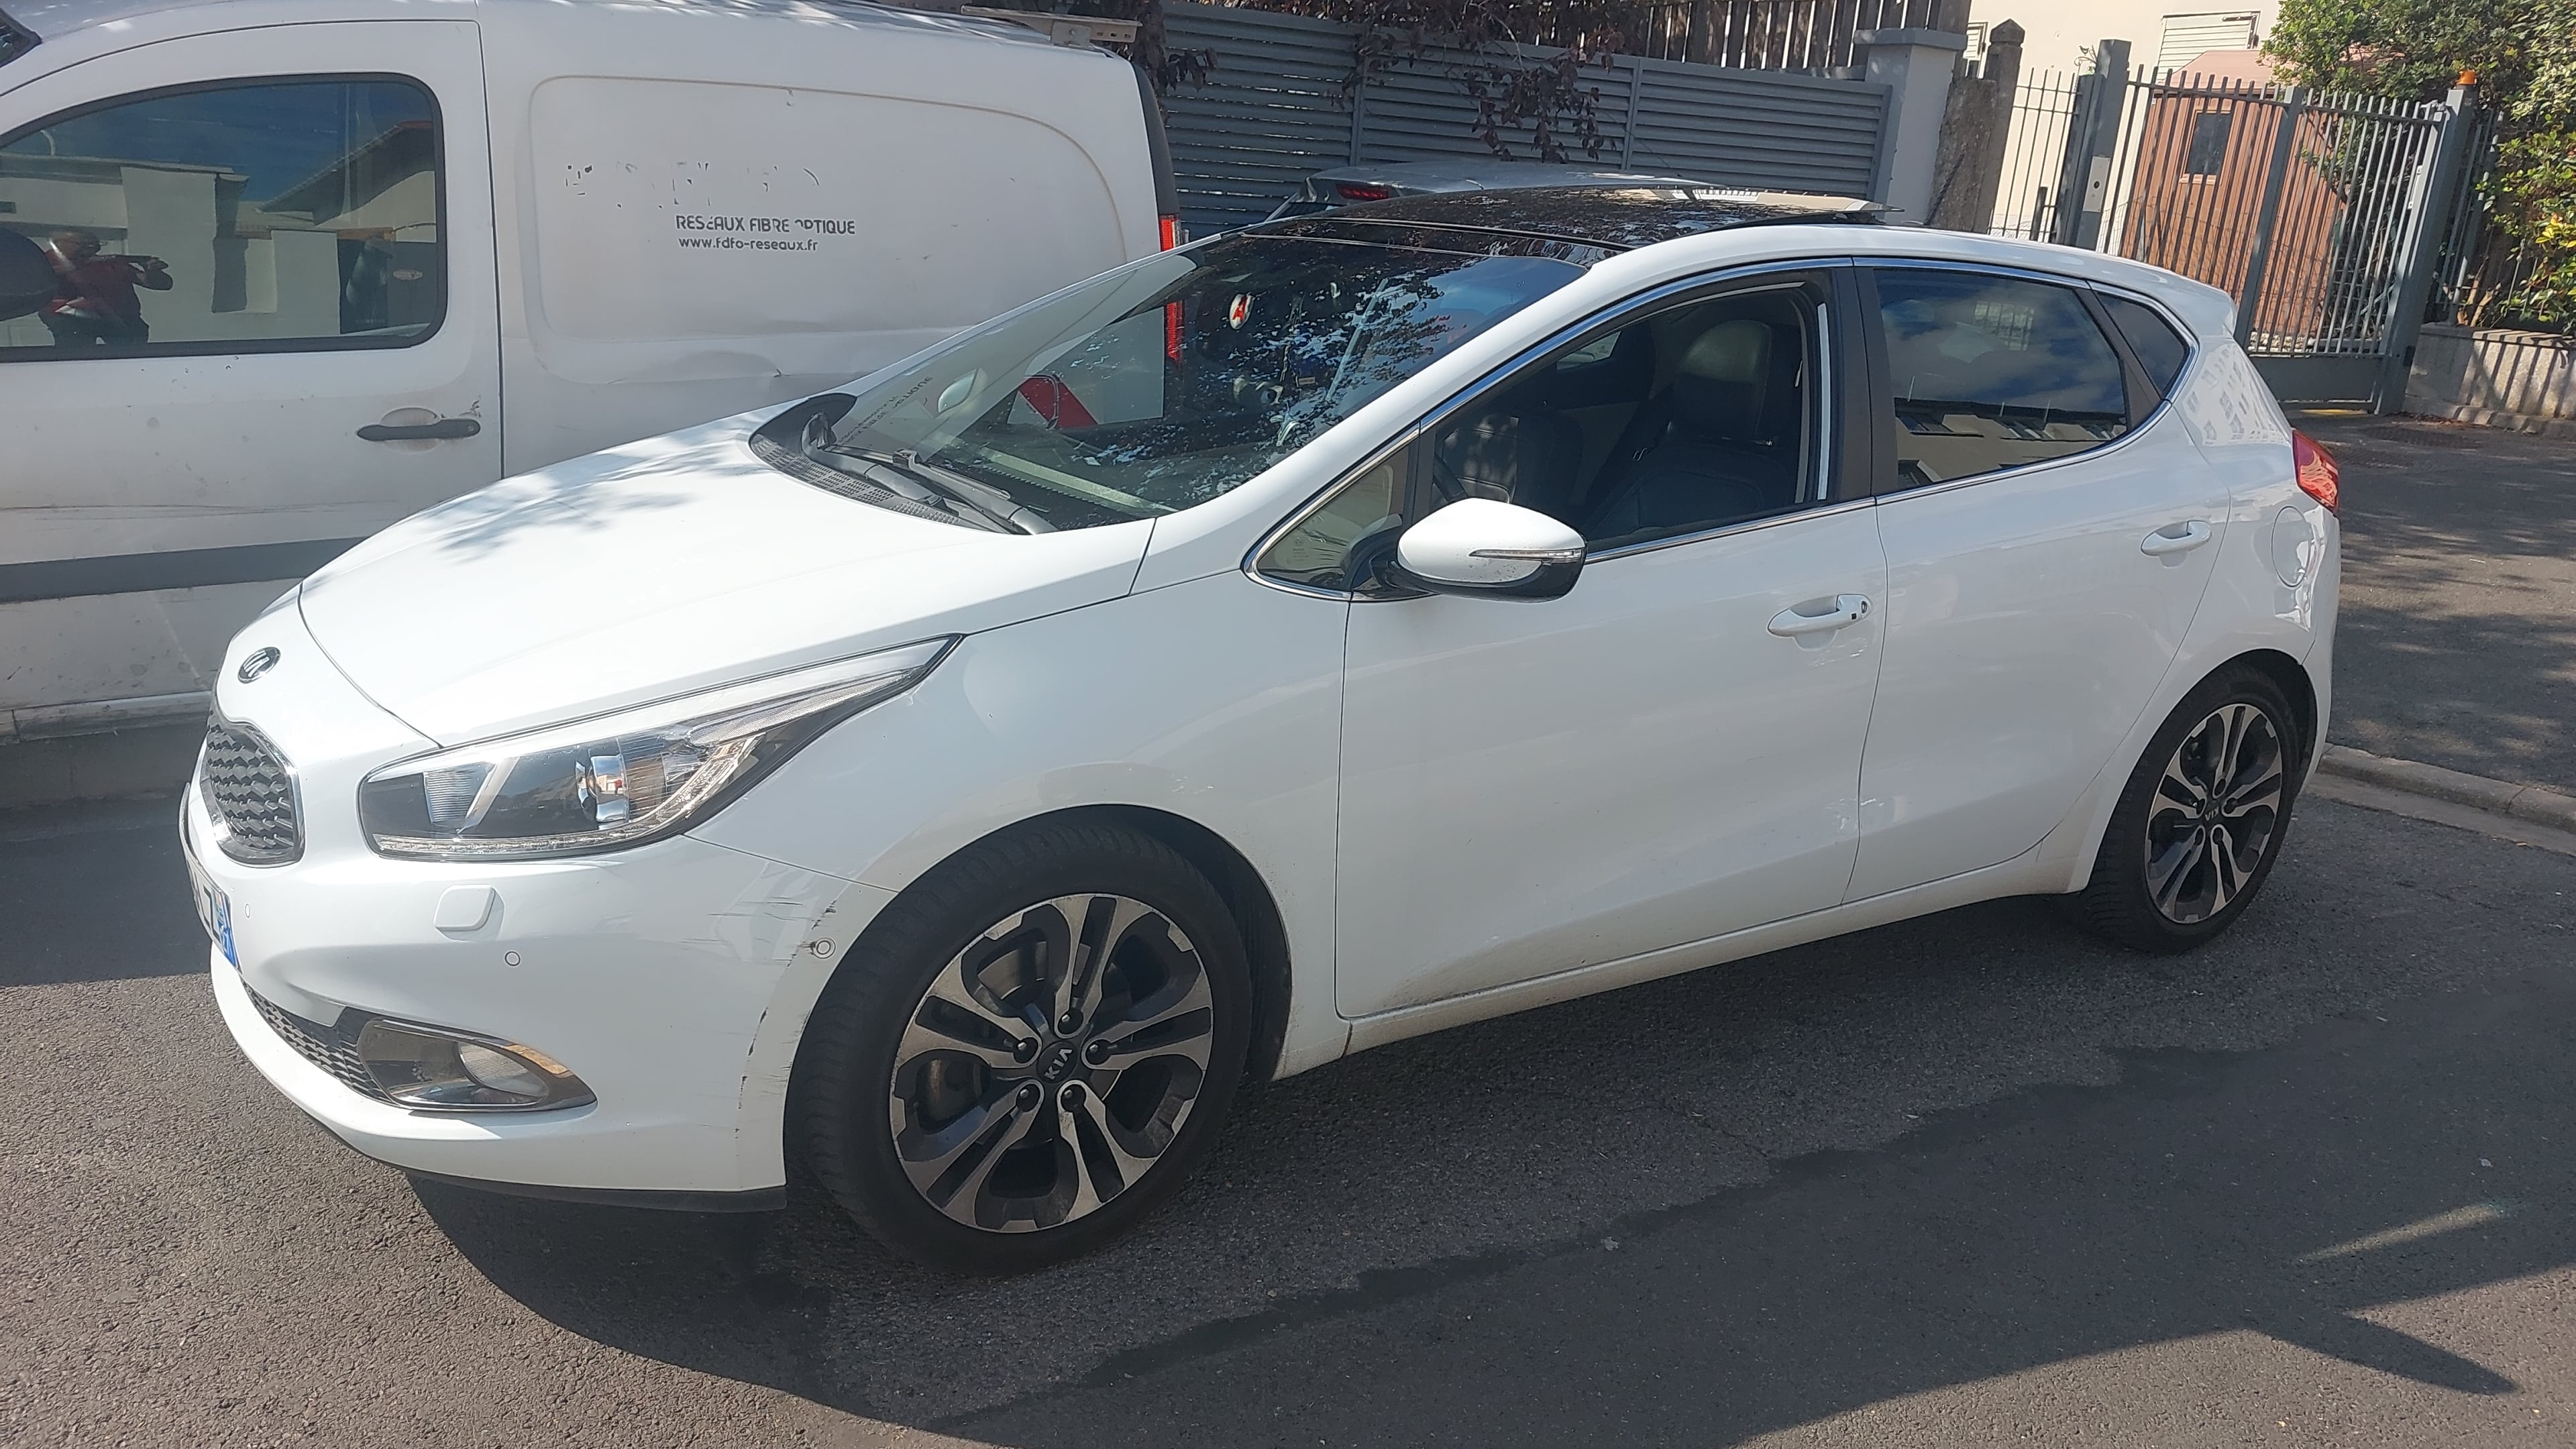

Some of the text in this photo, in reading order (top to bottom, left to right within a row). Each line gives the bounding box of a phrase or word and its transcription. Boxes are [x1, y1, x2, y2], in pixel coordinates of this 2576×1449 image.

[676, 215, 745, 231] RESEAUX
[749, 217, 790, 233] FIBRE
[678, 236, 818, 252] www.fdfo-reseaux.fr
[2204, 806, 2219, 821] KIA
[1044, 1049, 1073, 1080] KIA
